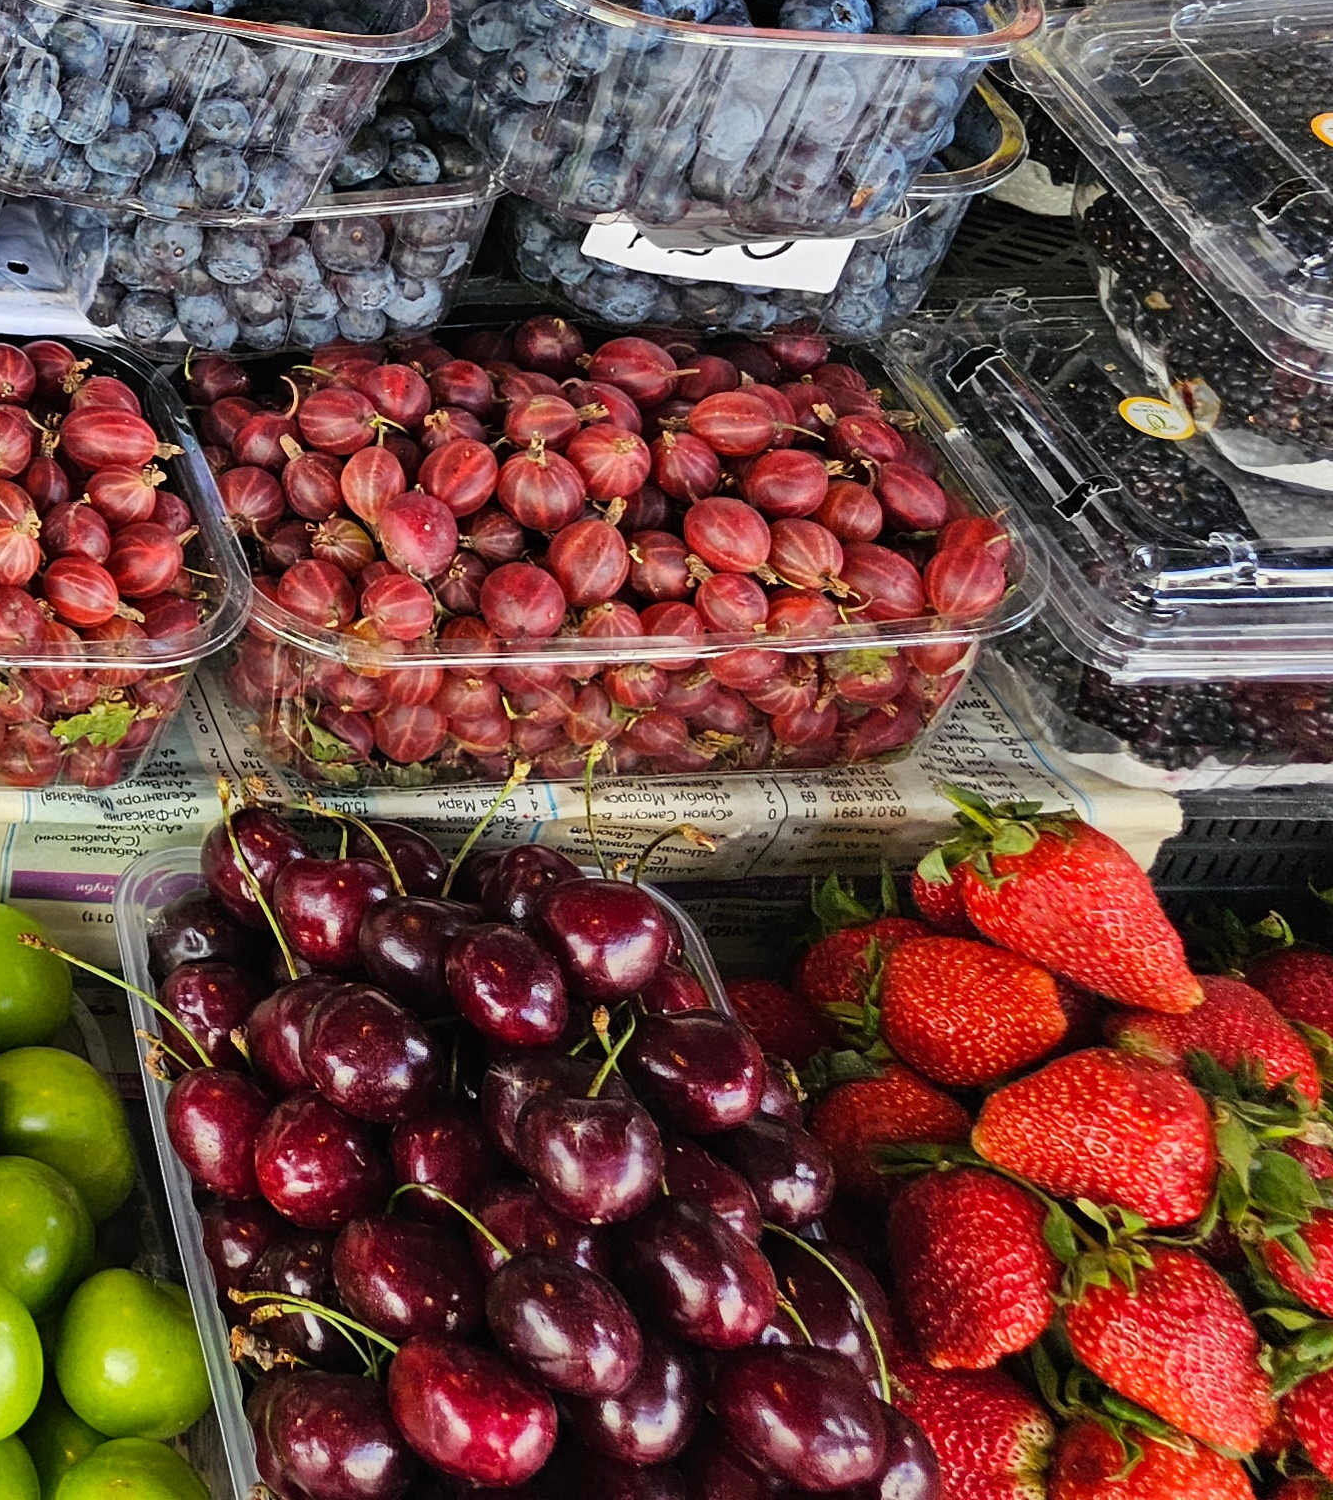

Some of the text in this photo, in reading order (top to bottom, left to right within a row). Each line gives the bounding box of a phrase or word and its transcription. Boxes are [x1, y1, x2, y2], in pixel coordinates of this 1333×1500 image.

[828, 789, 901, 803] 13.06.1992
[833, 806, 907, 818] 09.07.1991
[82, 911, 114, 924] 011)
